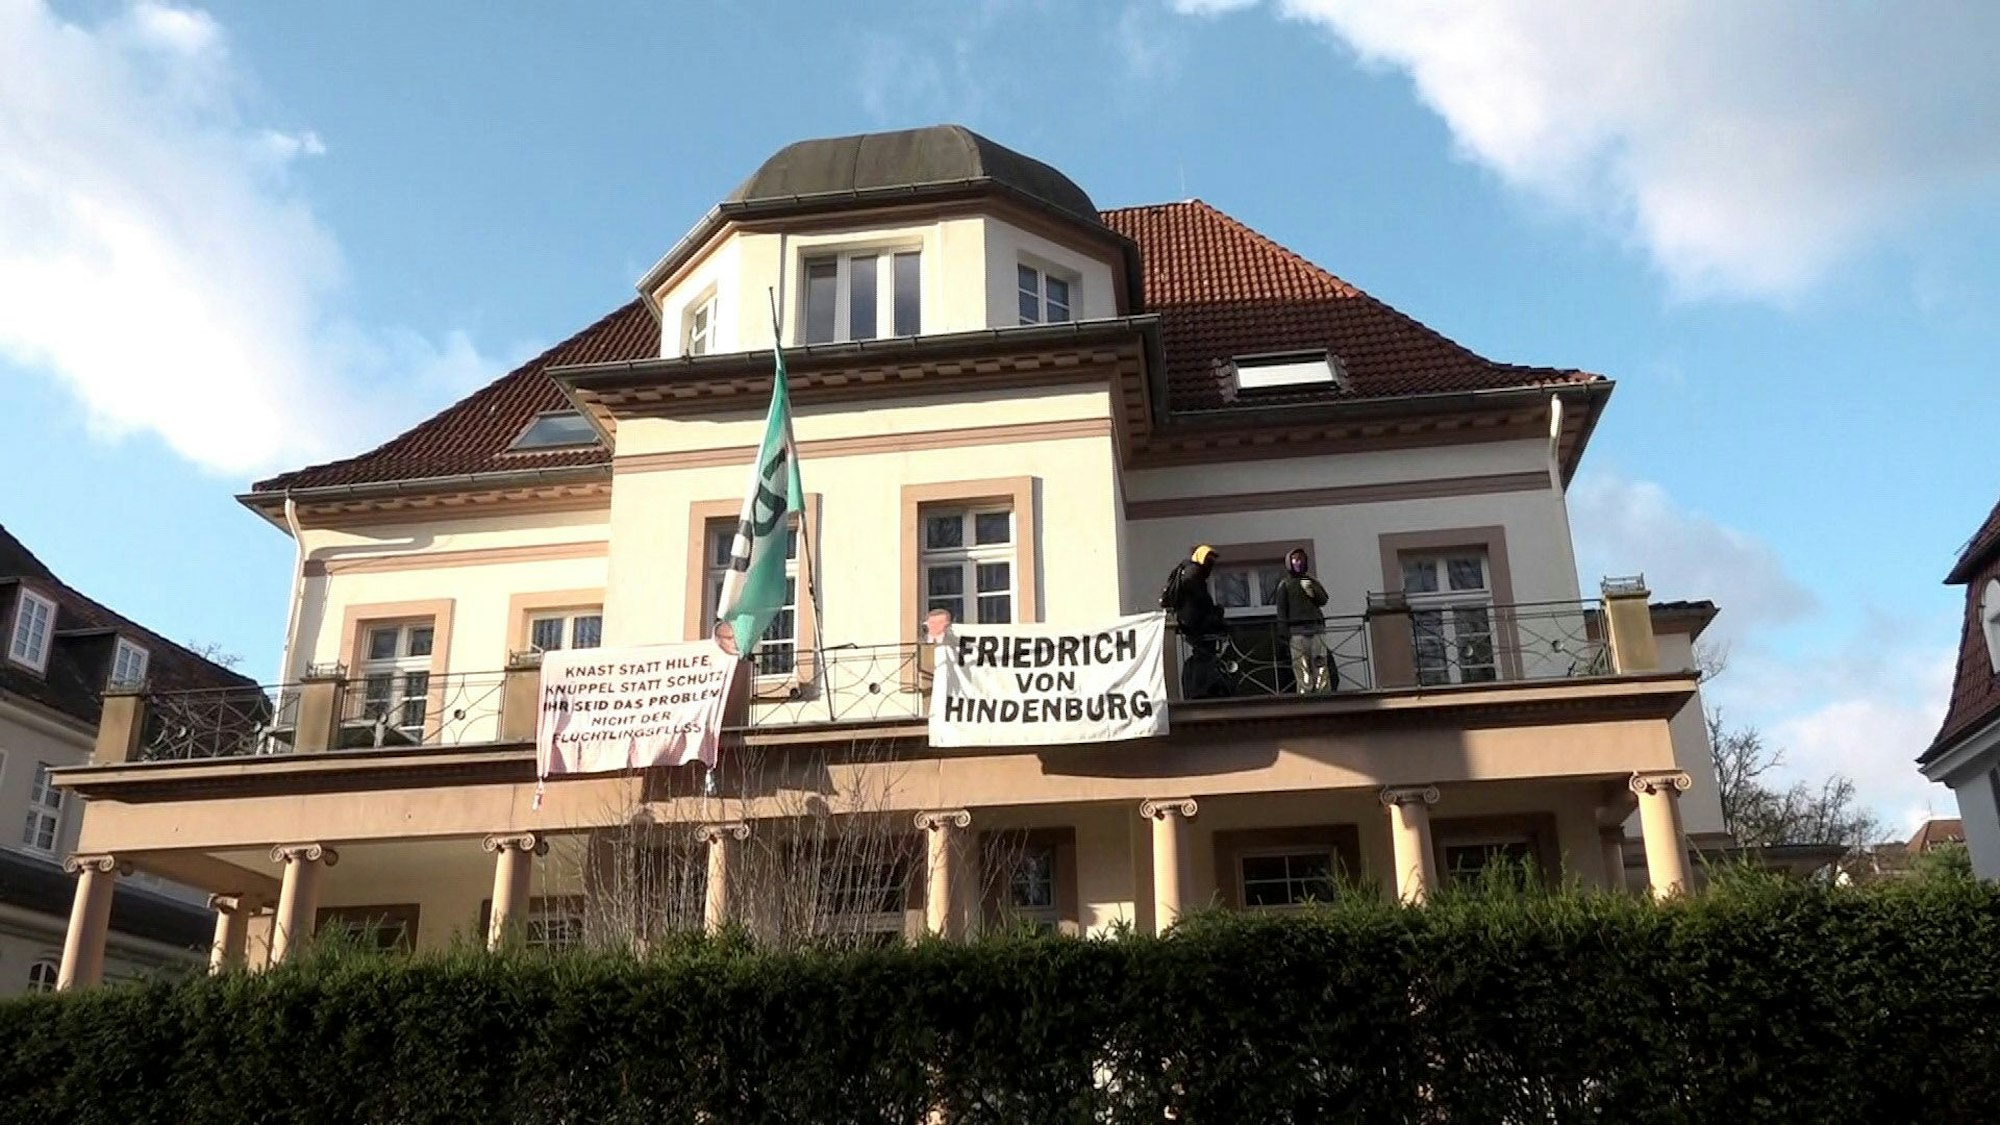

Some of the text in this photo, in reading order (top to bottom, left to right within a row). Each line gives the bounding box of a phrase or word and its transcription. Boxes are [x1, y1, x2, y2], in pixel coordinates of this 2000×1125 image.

[957, 628, 1136, 668] FRIEDRICH
[565, 664, 615, 678] KNAST
[619, 661, 662, 676] STATT
[620, 679, 662, 693] STATT
[1015, 671, 1076, 693] VON
[543, 701, 569, 713] IHR
[574, 700, 609, 712] SEID
[613, 698, 644, 710] DAS
[944, 690, 1153, 724] HINDENBURG
[591, 711, 671, 727] NICHT DER
